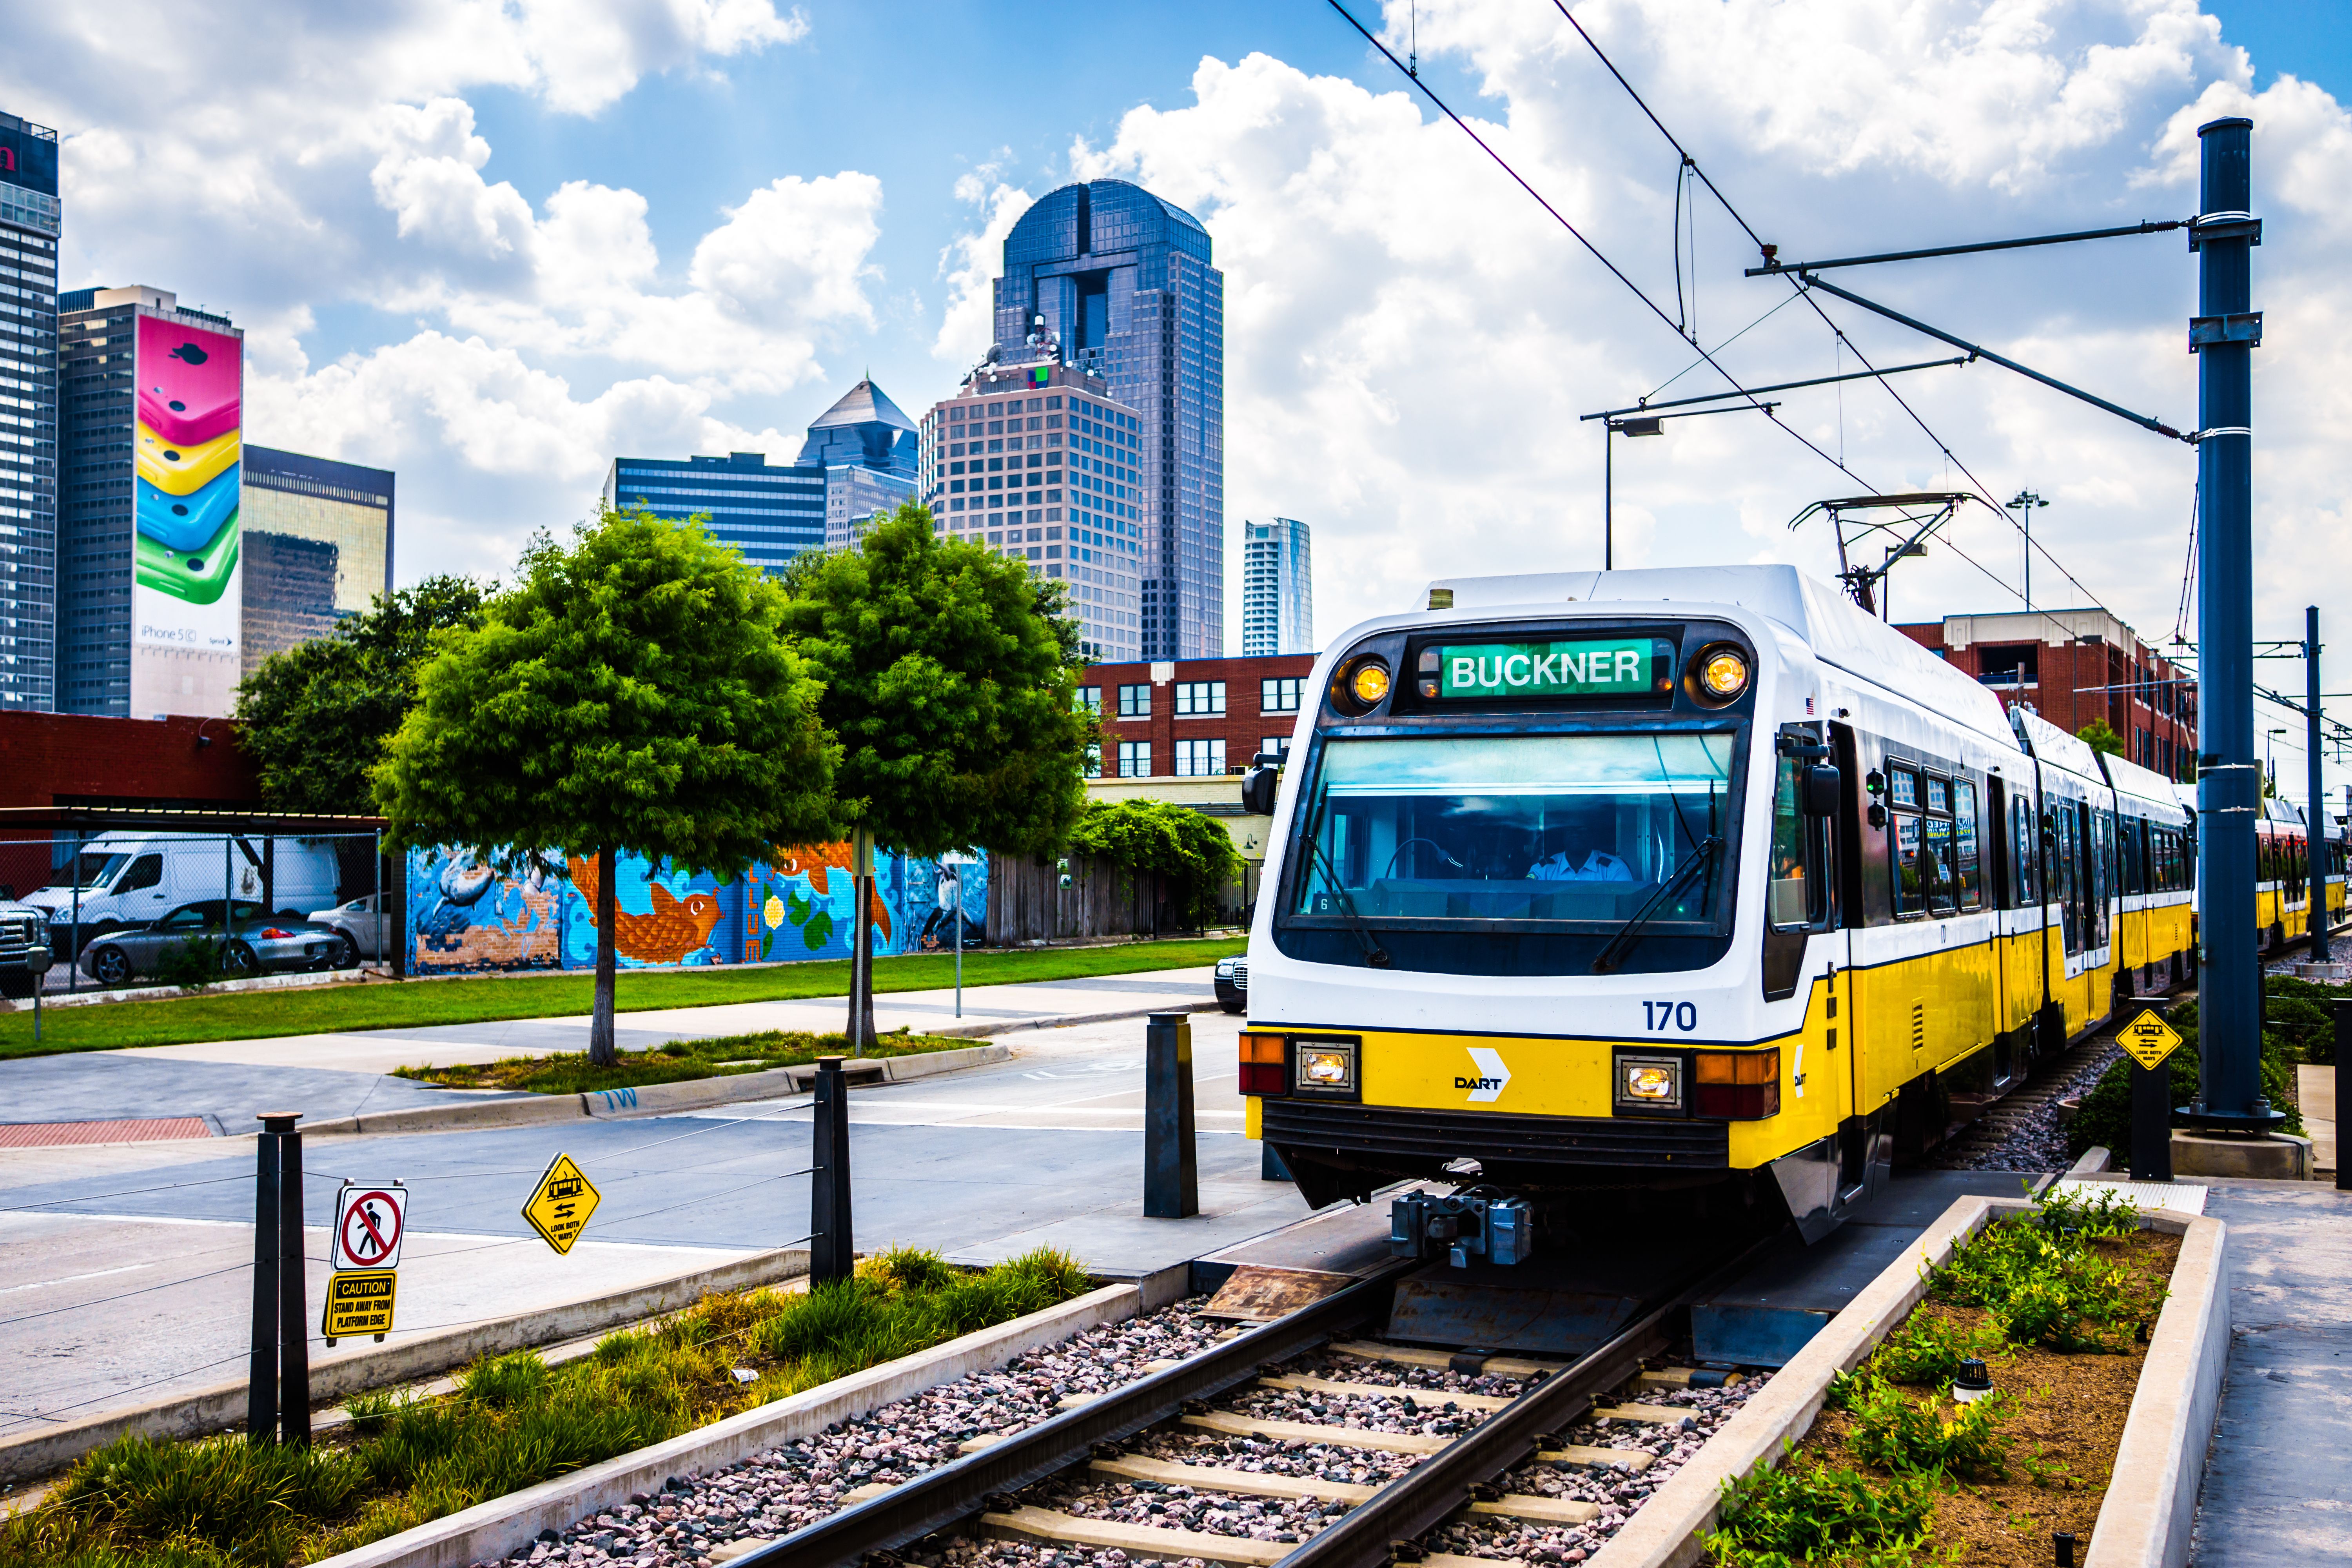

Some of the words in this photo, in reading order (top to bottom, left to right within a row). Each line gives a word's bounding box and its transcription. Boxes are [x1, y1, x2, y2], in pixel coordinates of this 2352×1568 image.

[142, 625, 175, 639] iPhone
[178, 628, 184, 641] 5
[1452, 650, 1640, 688] BUCKNER
[1642, 1001, 1697, 1031] 170
[1455, 1077, 1502, 1090] DART
[1795, 1073, 1806, 1087] DART
[551, 1223, 565, 1232] LOOK
[566, 1220, 580, 1229] BOTH
[558, 1232, 573, 1241] WAYS
[342, 1281, 386, 1295] CAUTION
[334, 1301, 354, 1314] STAND
[355, 1300, 372, 1312] AWAY
[373, 1299, 390, 1311] FROM
[337, 1315, 369, 1328] PLATFORM
[370, 1314, 385, 1325] EDGE
